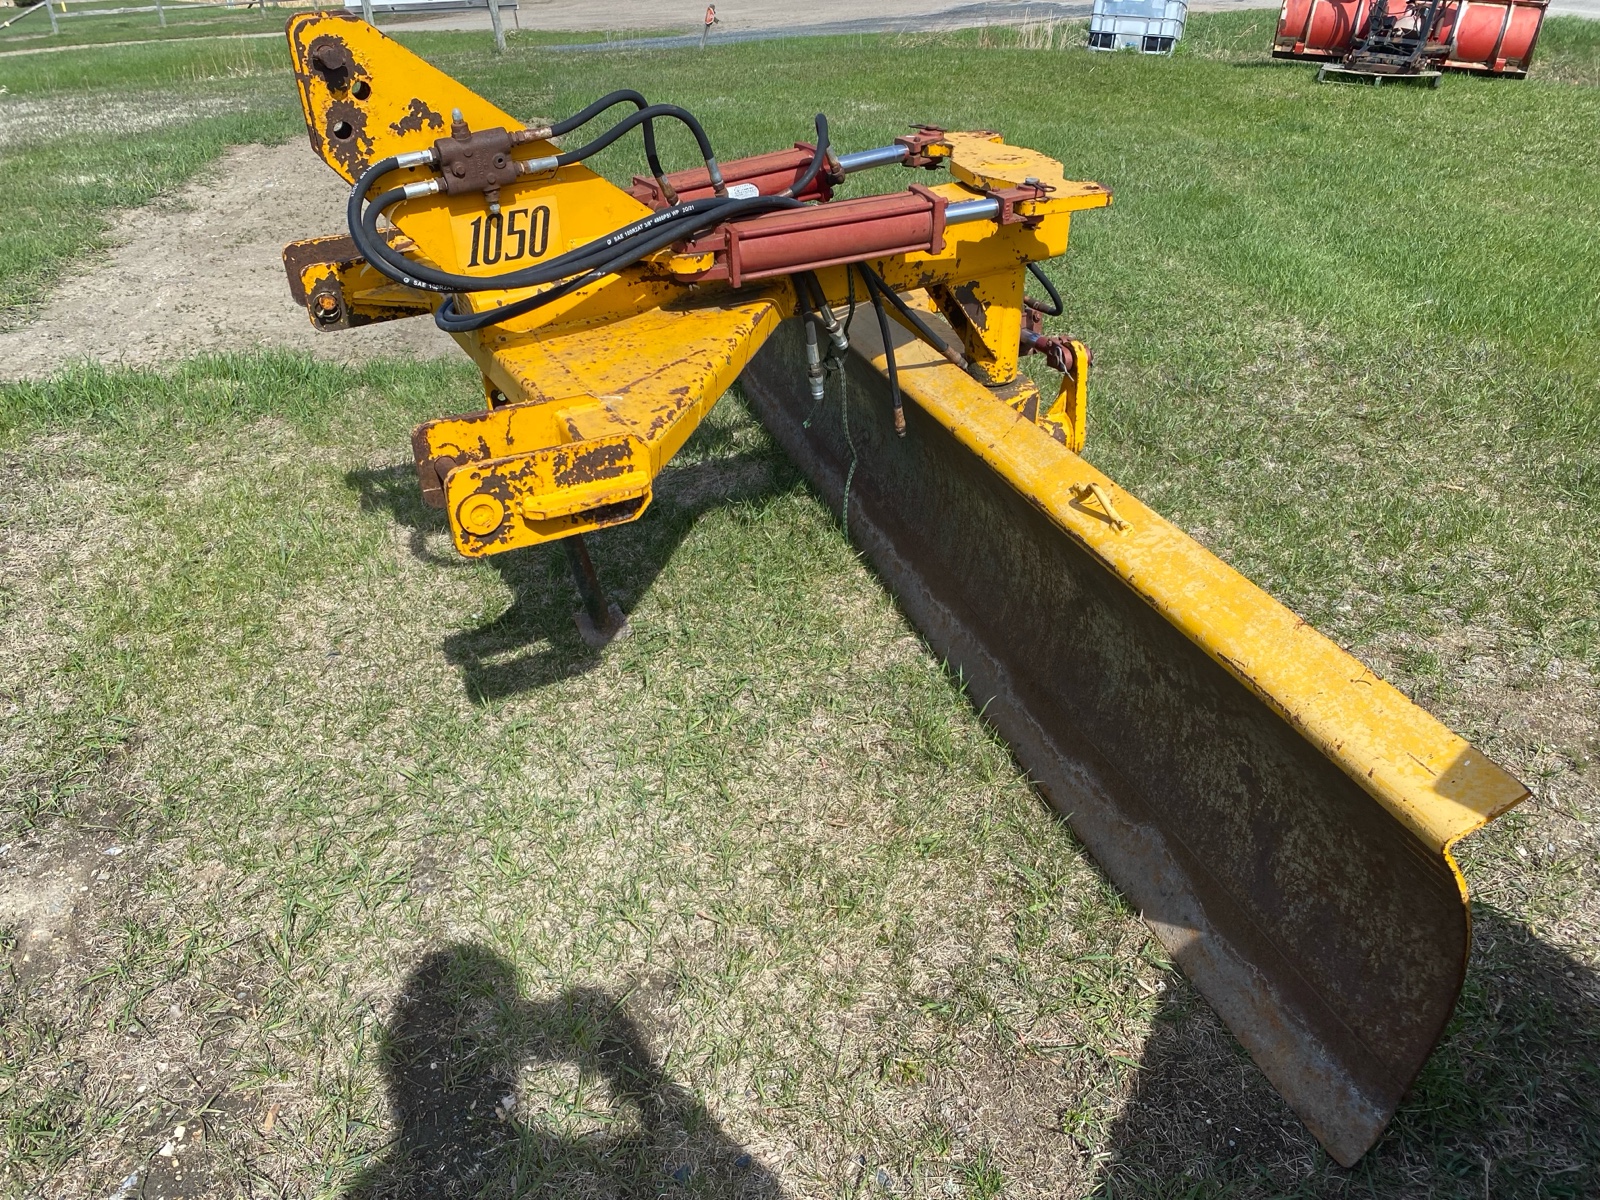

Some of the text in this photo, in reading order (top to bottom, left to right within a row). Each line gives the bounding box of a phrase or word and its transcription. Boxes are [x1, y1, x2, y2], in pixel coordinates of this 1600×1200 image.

[467, 205, 551, 268] 1050
[613, 233, 624, 242] SAE
[671, 209, 680, 217] WP
[413, 280, 427, 288] SAE
